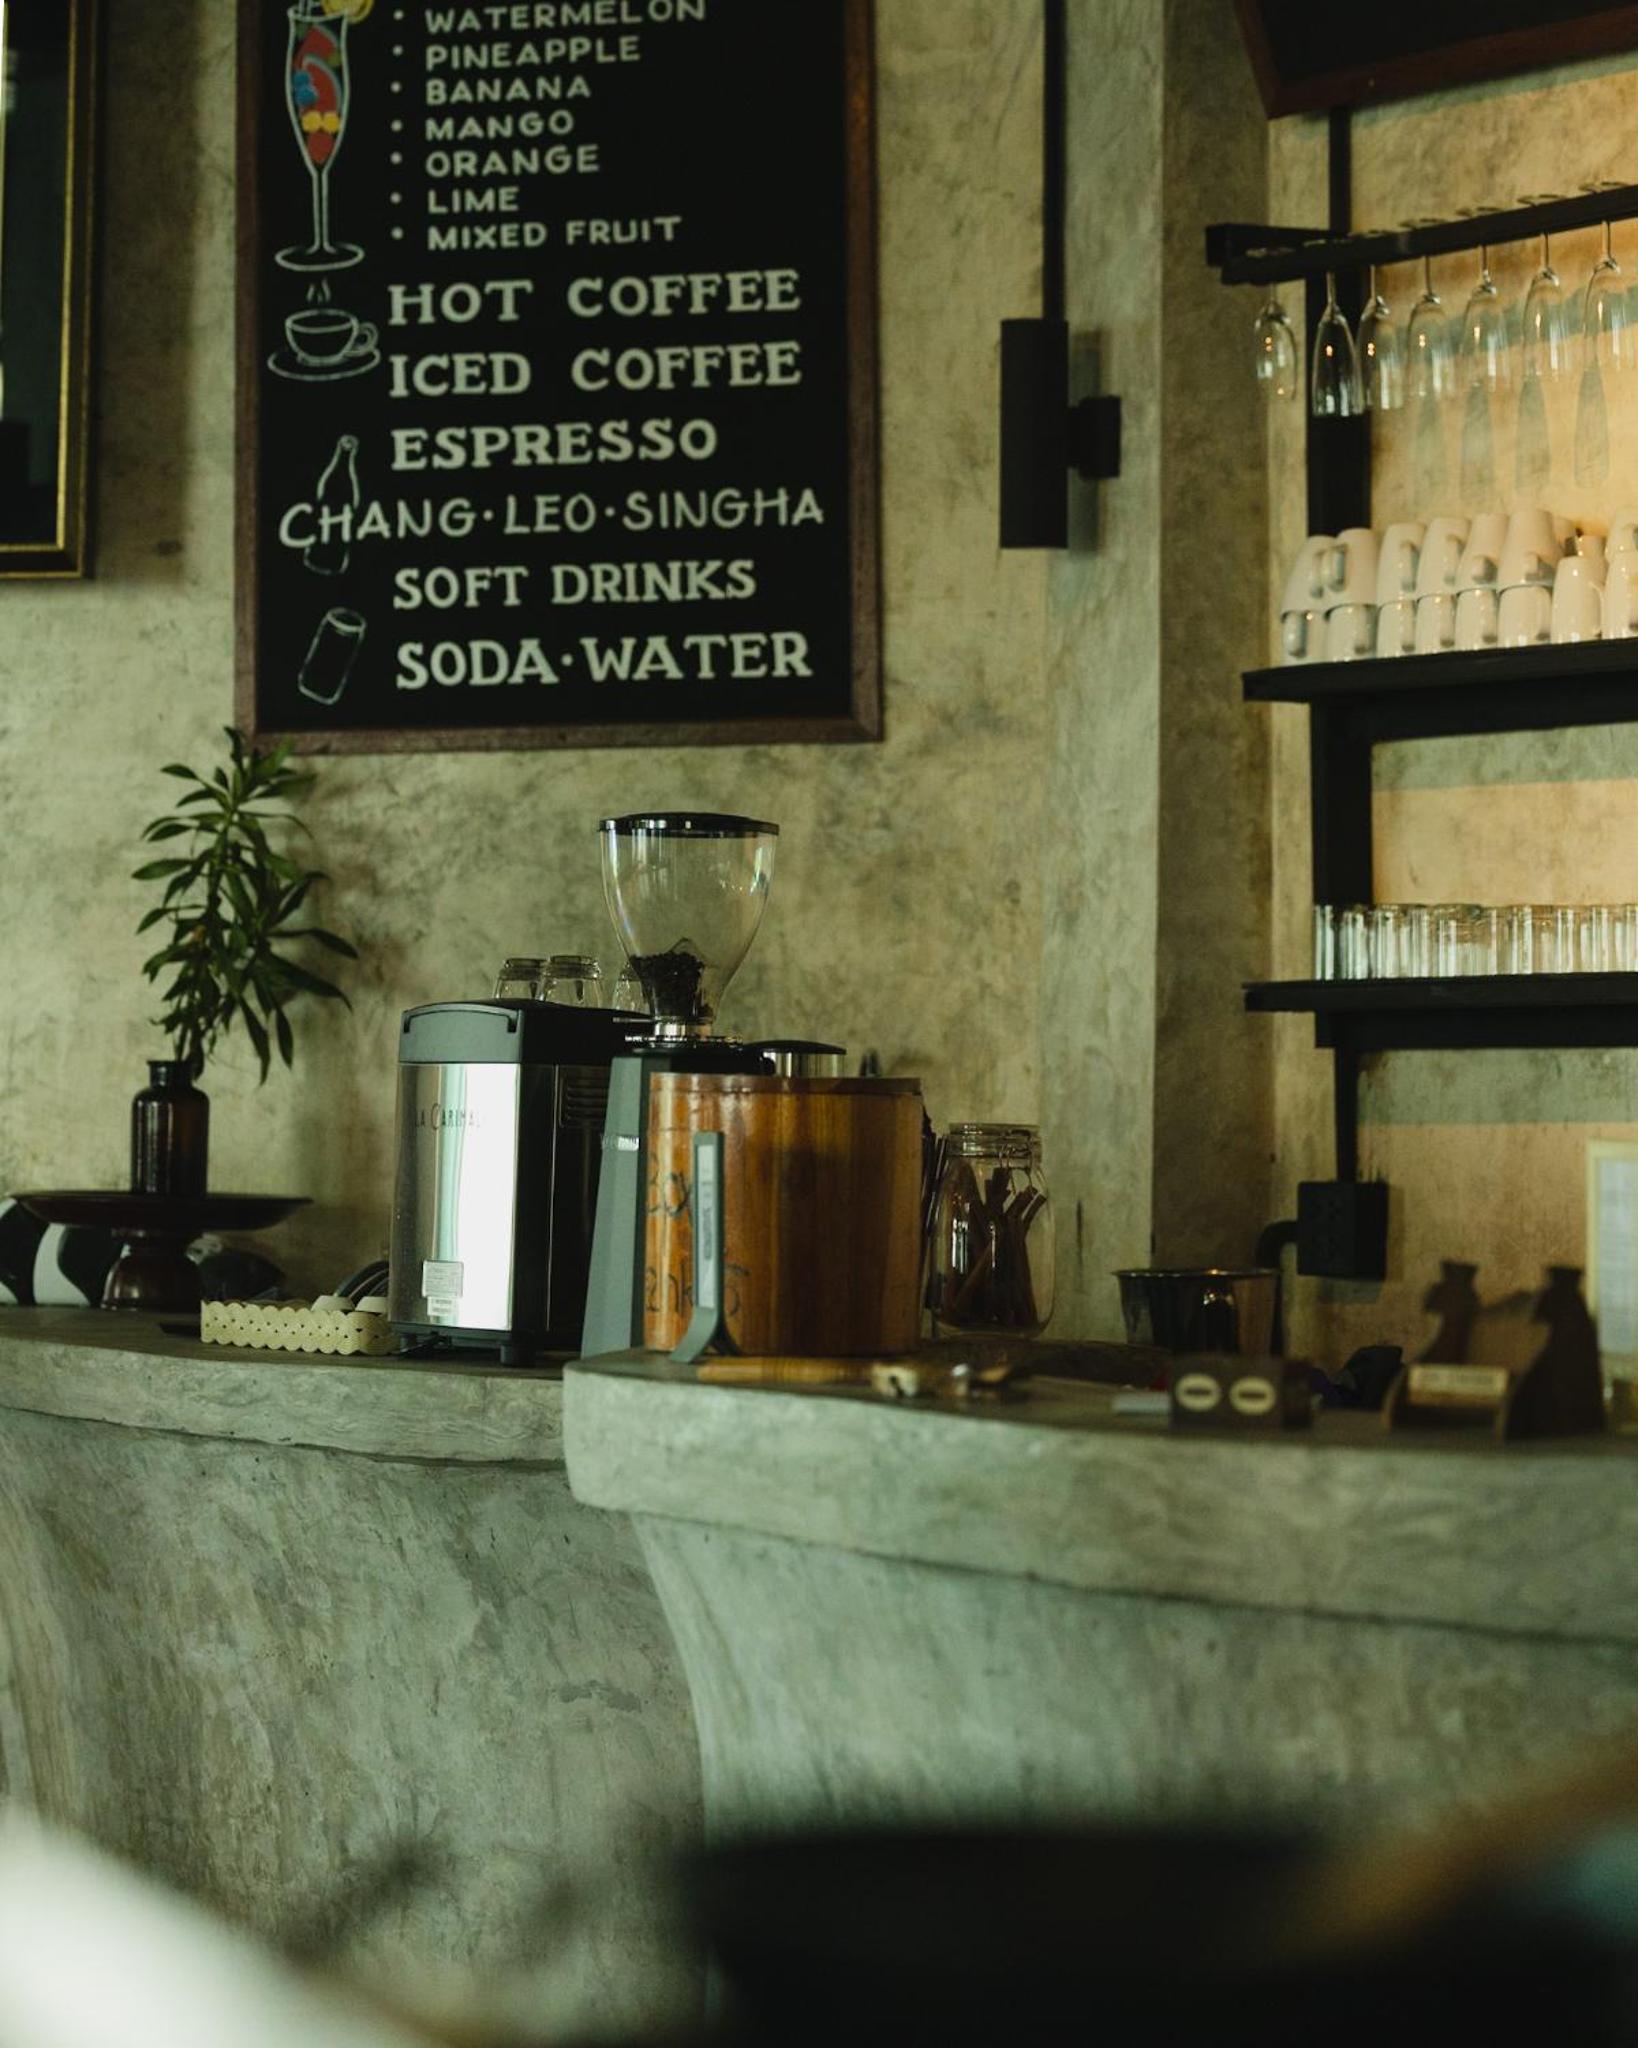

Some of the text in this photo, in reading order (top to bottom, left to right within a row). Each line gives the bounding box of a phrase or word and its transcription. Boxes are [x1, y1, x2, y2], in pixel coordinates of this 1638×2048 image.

[424, 0, 706, 35] WATERMELON
[424, 35, 641, 72] PINEAPPLE
[425, 75, 591, 106] BANANA
[424, 109, 575, 142] MANGO
[424, 144, 600, 178] ORANGE
[427, 186, 520, 215] LIME
[426, 216, 682, 252] MIXED FRUIT
[387, 268, 802, 327] HOT COFFEE
[388, 340, 802, 400] ICED COFFEE
[389, 417, 719, 472] ESPRESSO
[391, 558, 758, 611] SOFT DRINKS
